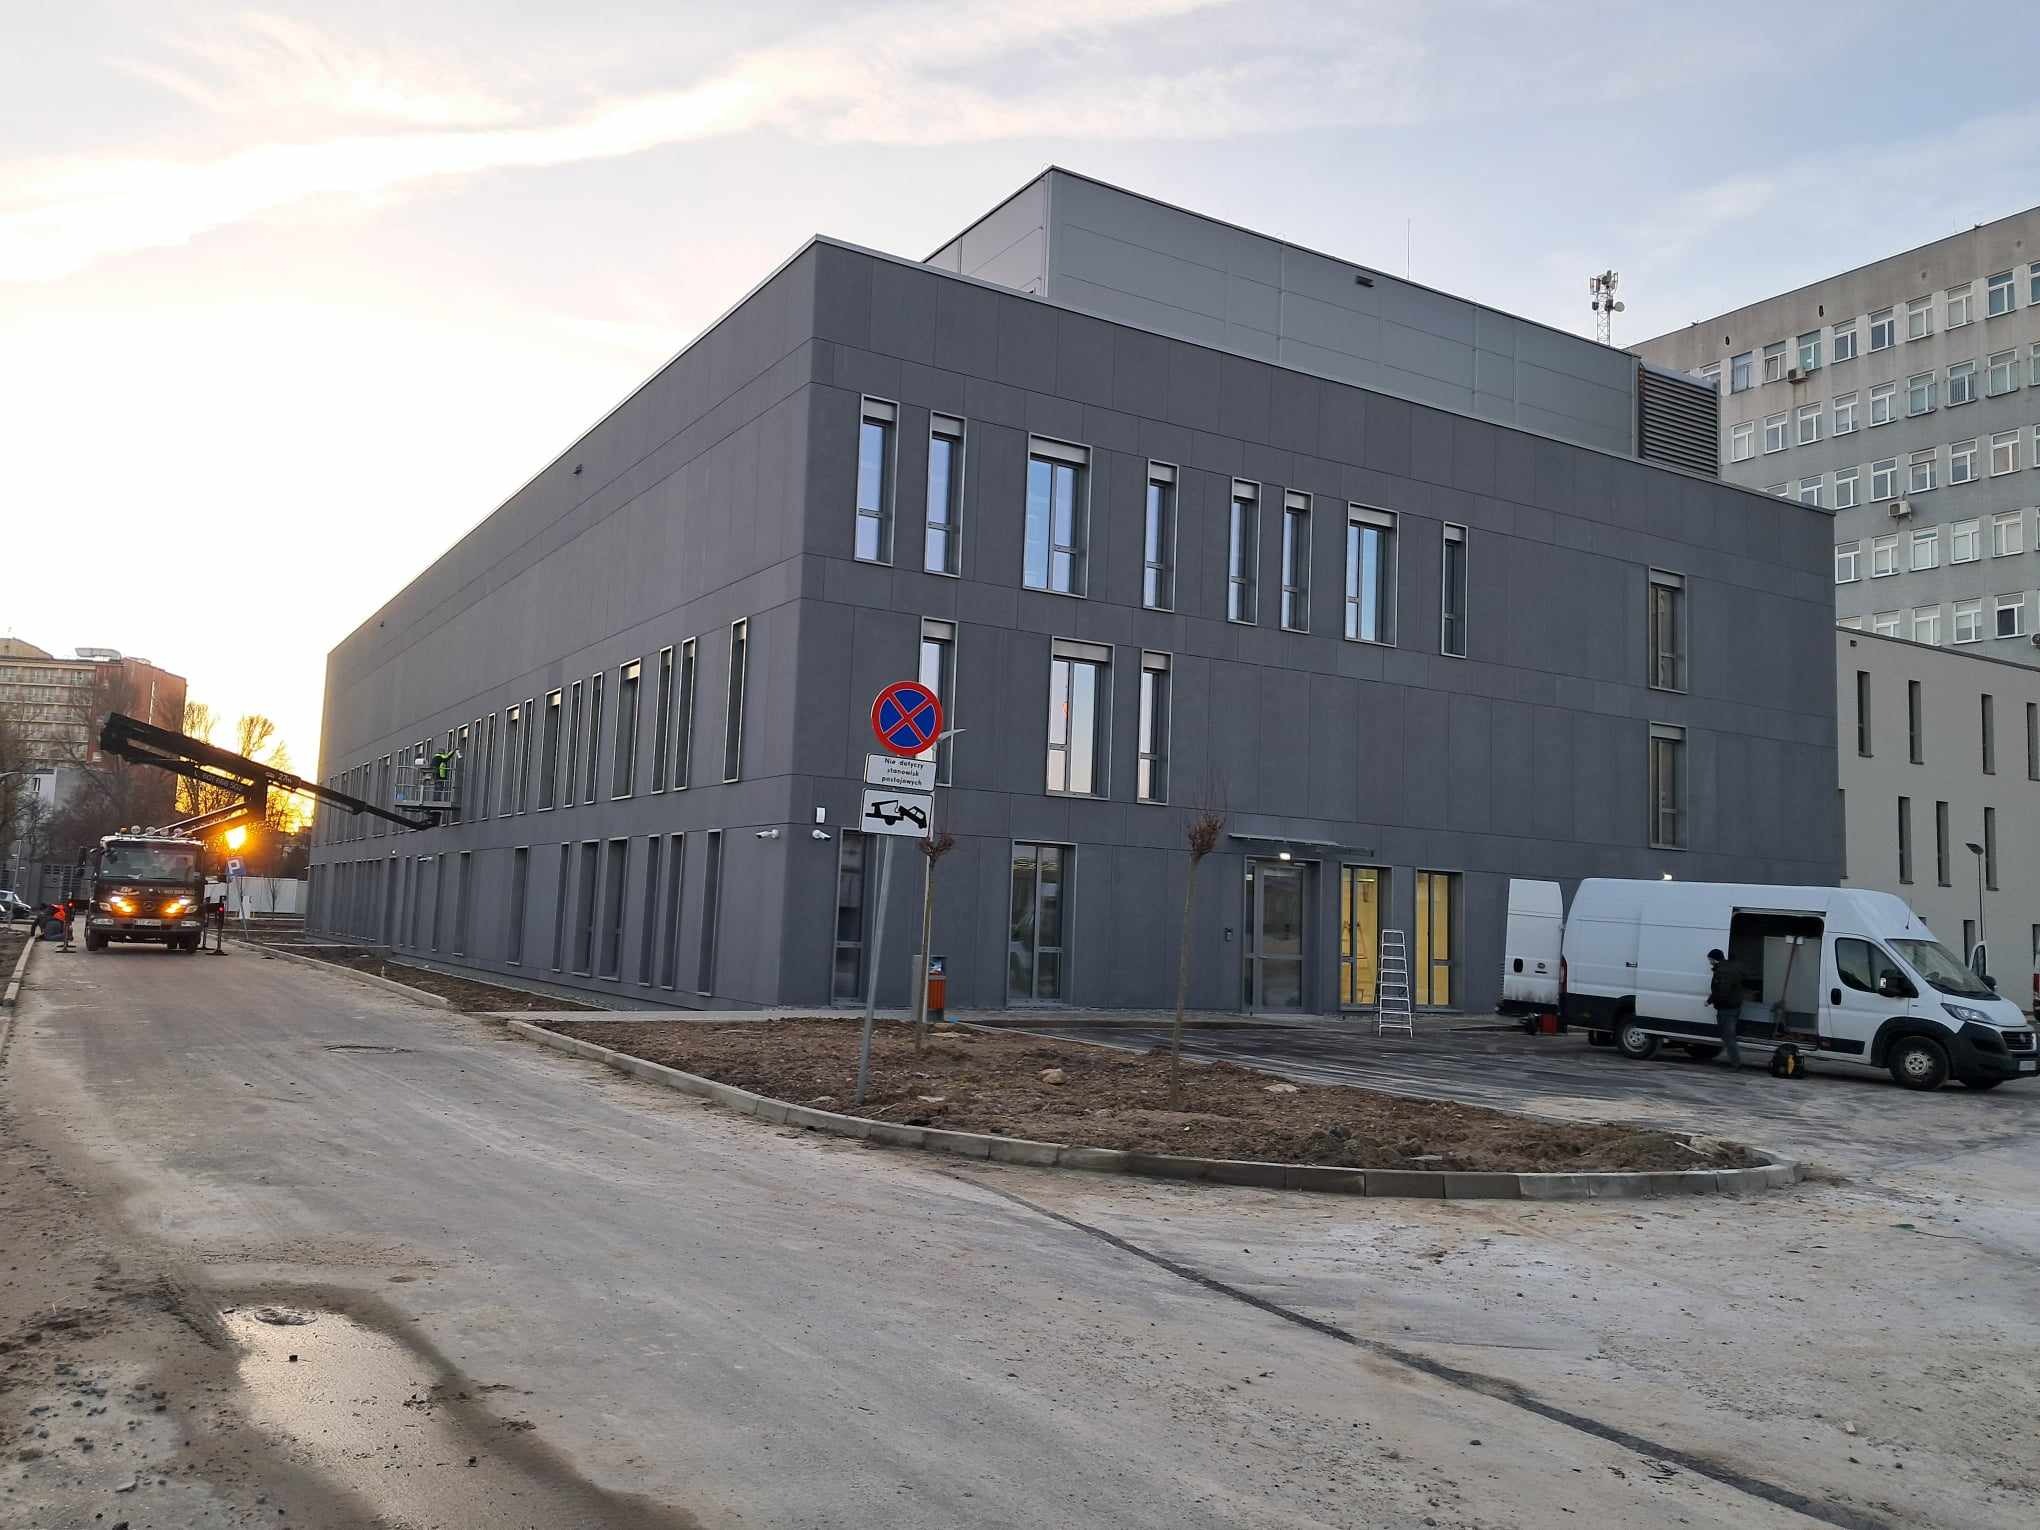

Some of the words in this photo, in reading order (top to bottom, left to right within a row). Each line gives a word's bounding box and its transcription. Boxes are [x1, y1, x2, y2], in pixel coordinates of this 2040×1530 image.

[899, 760, 924, 769] dotyczy
[887, 768, 919, 777] stanowisk
[881, 776, 922, 786] postojowych
[228, 859, 240, 875] P
